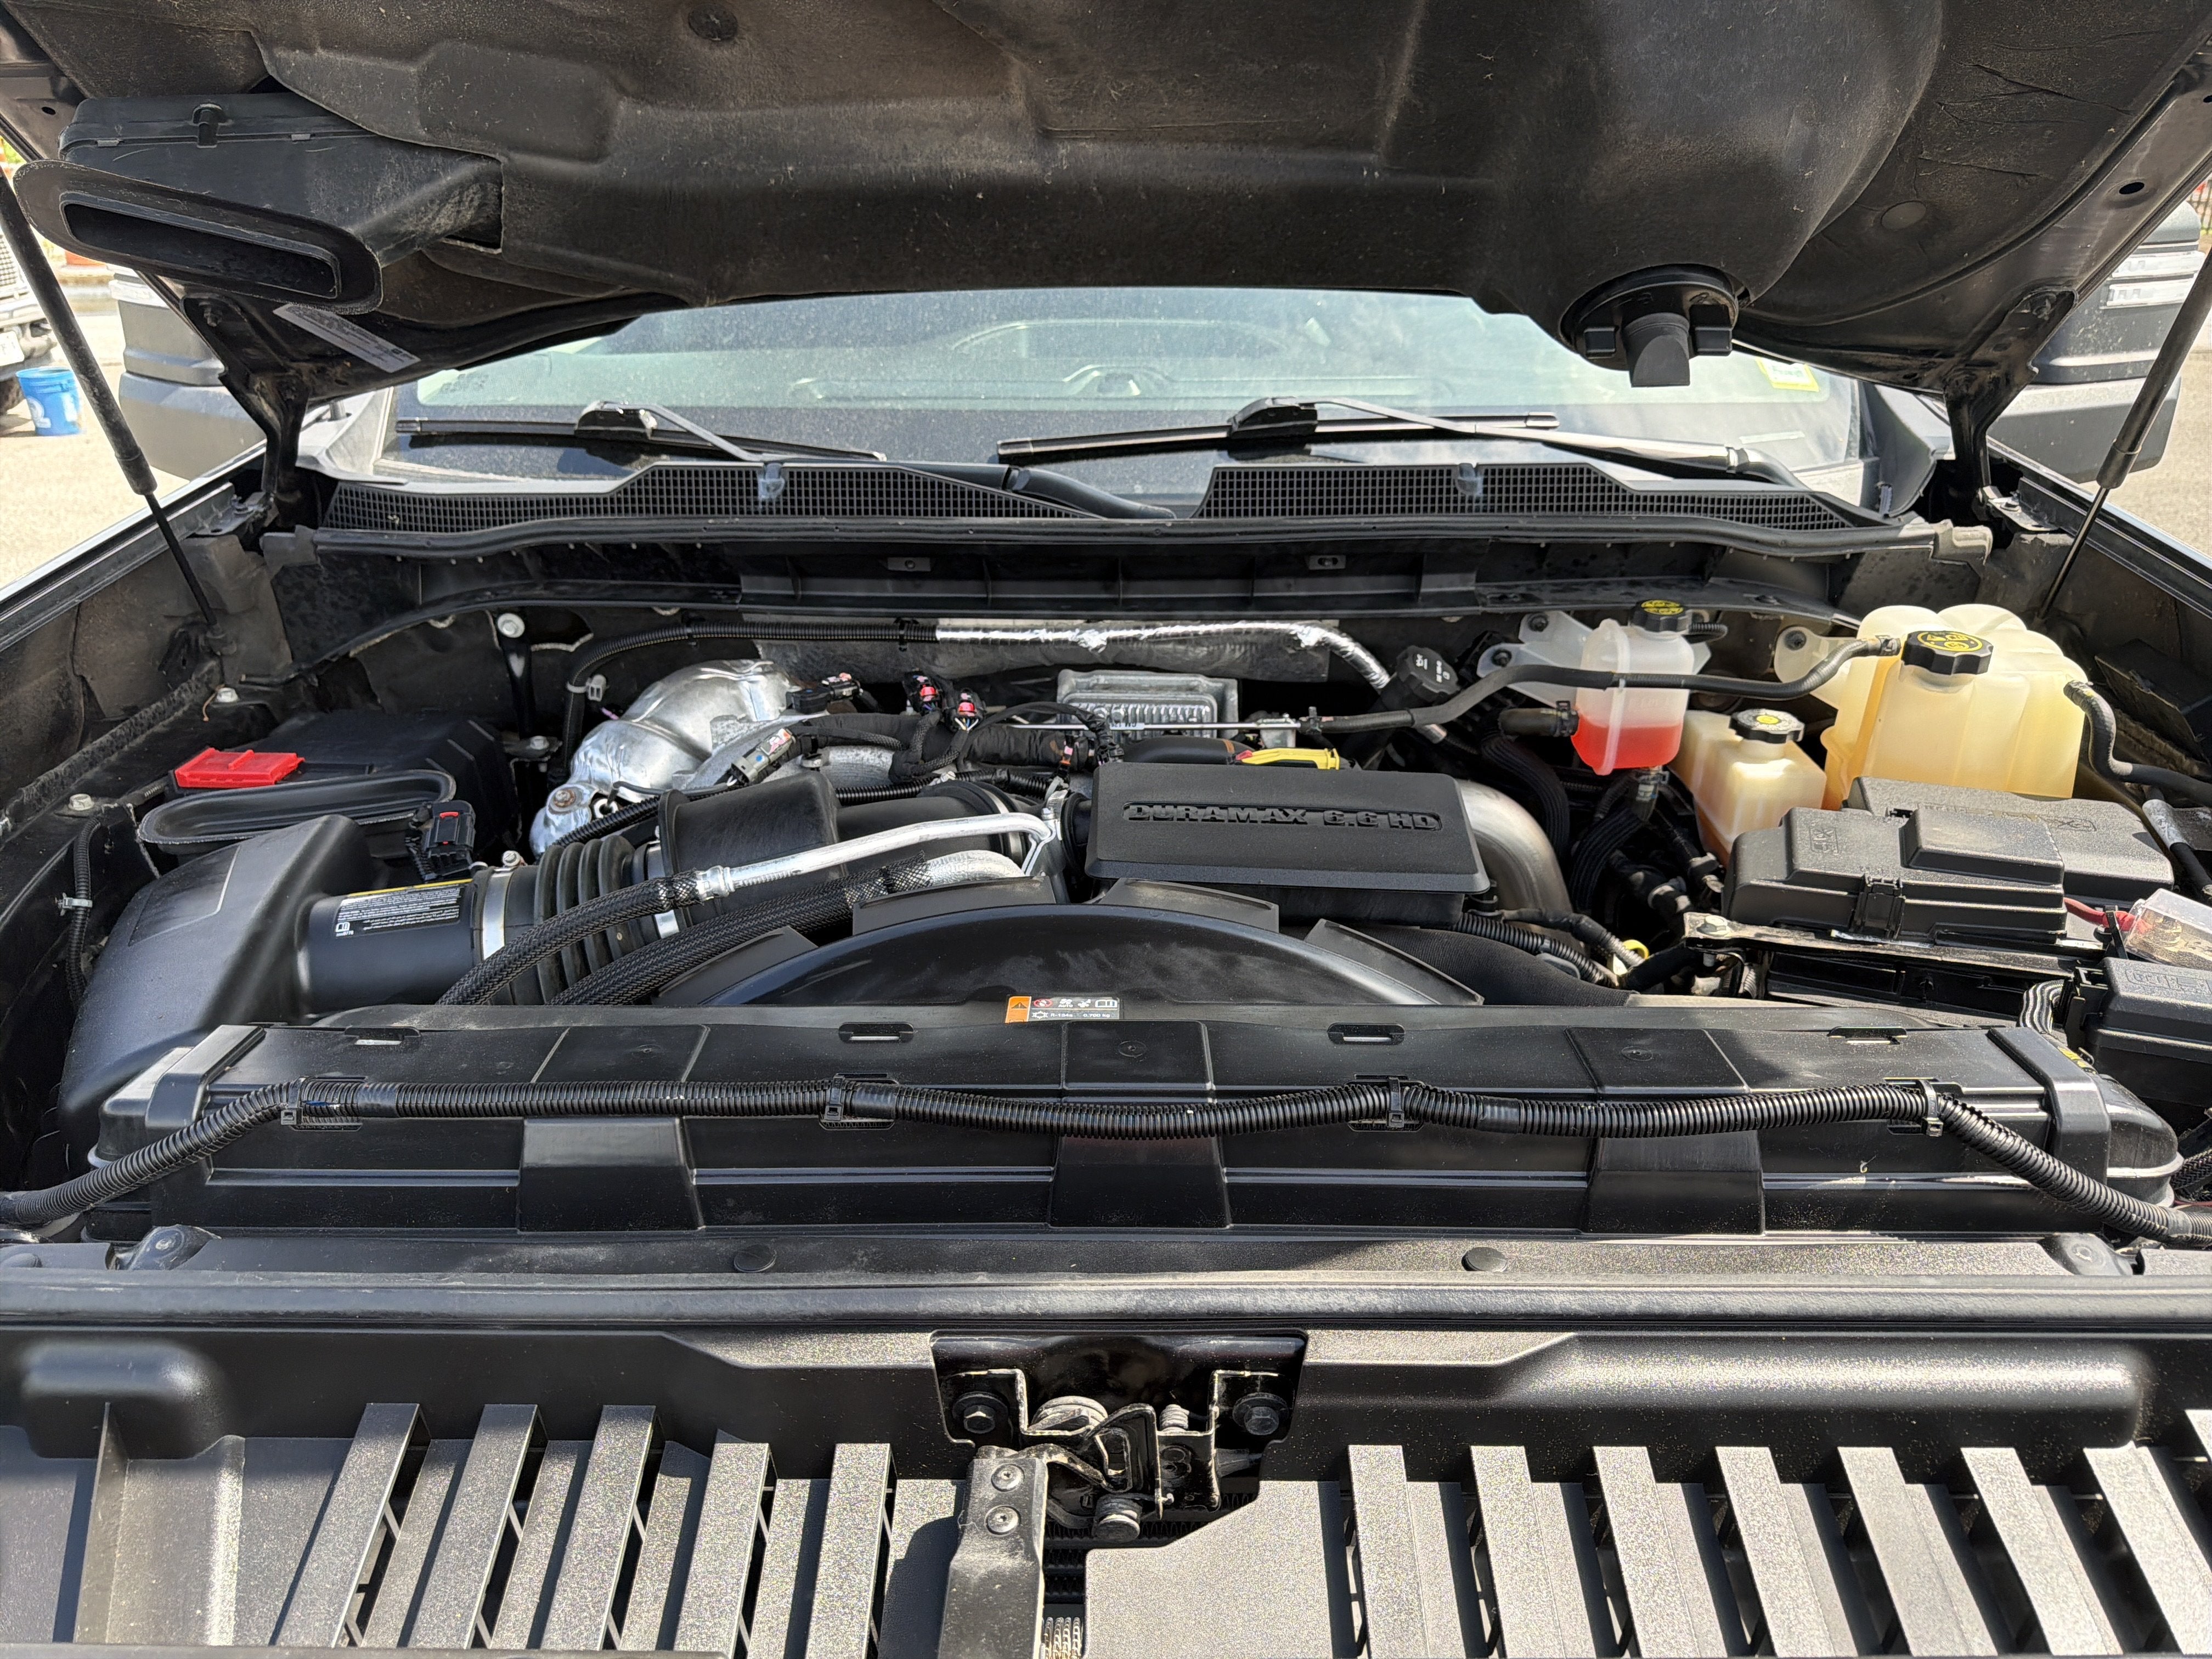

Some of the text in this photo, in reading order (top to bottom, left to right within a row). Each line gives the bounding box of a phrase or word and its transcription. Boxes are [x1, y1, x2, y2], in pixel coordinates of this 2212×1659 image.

[1127, 804, 1440, 831] DURAMAX 6.6 HD
